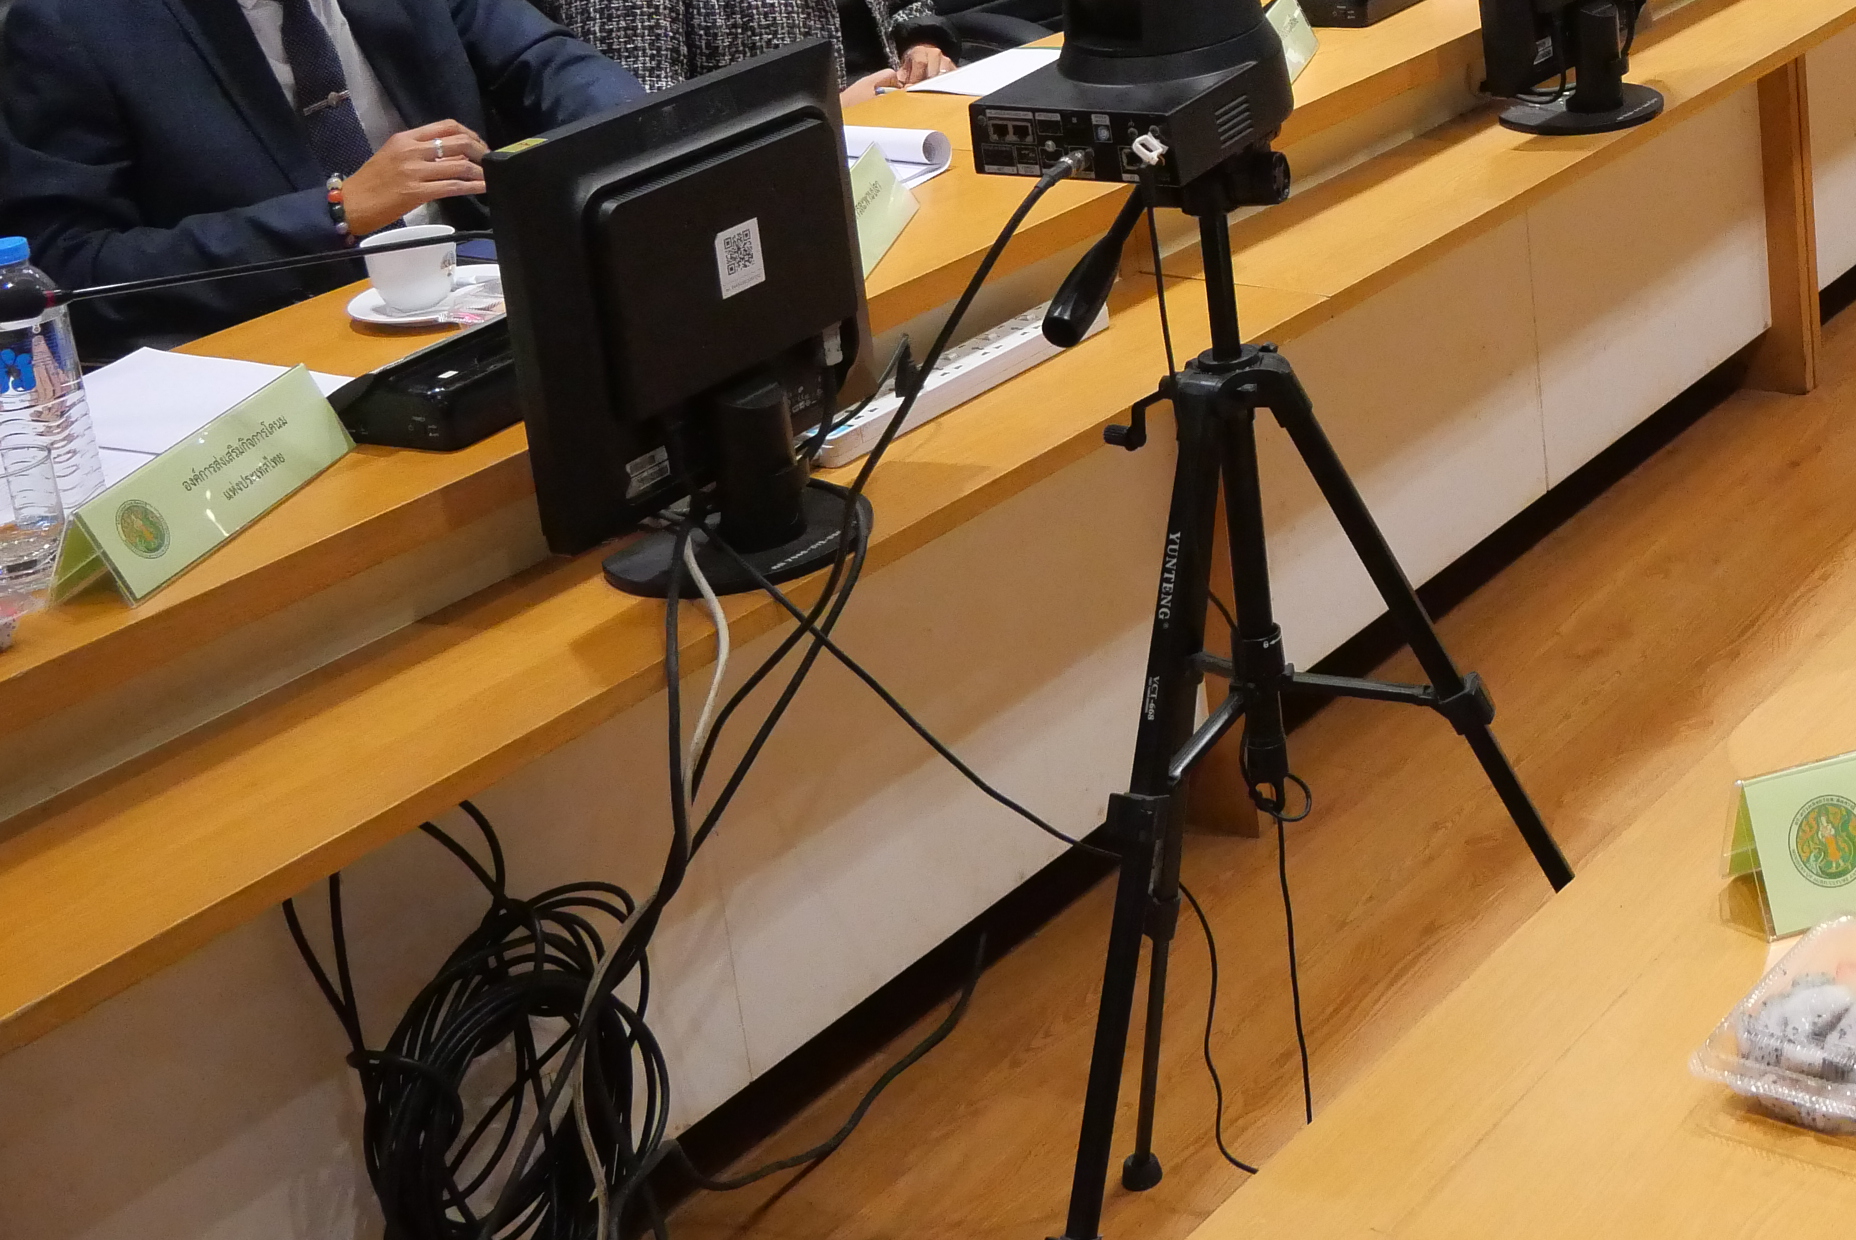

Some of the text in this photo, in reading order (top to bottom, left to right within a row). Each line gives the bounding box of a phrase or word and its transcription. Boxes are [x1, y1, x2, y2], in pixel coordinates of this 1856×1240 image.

[181, 414, 289, 492] องค์การส่งเสริมกิจการโคนม
[222, 452, 286, 501] แห่งประเทศไทย
[1158, 530, 1181, 621] YUNTENG
